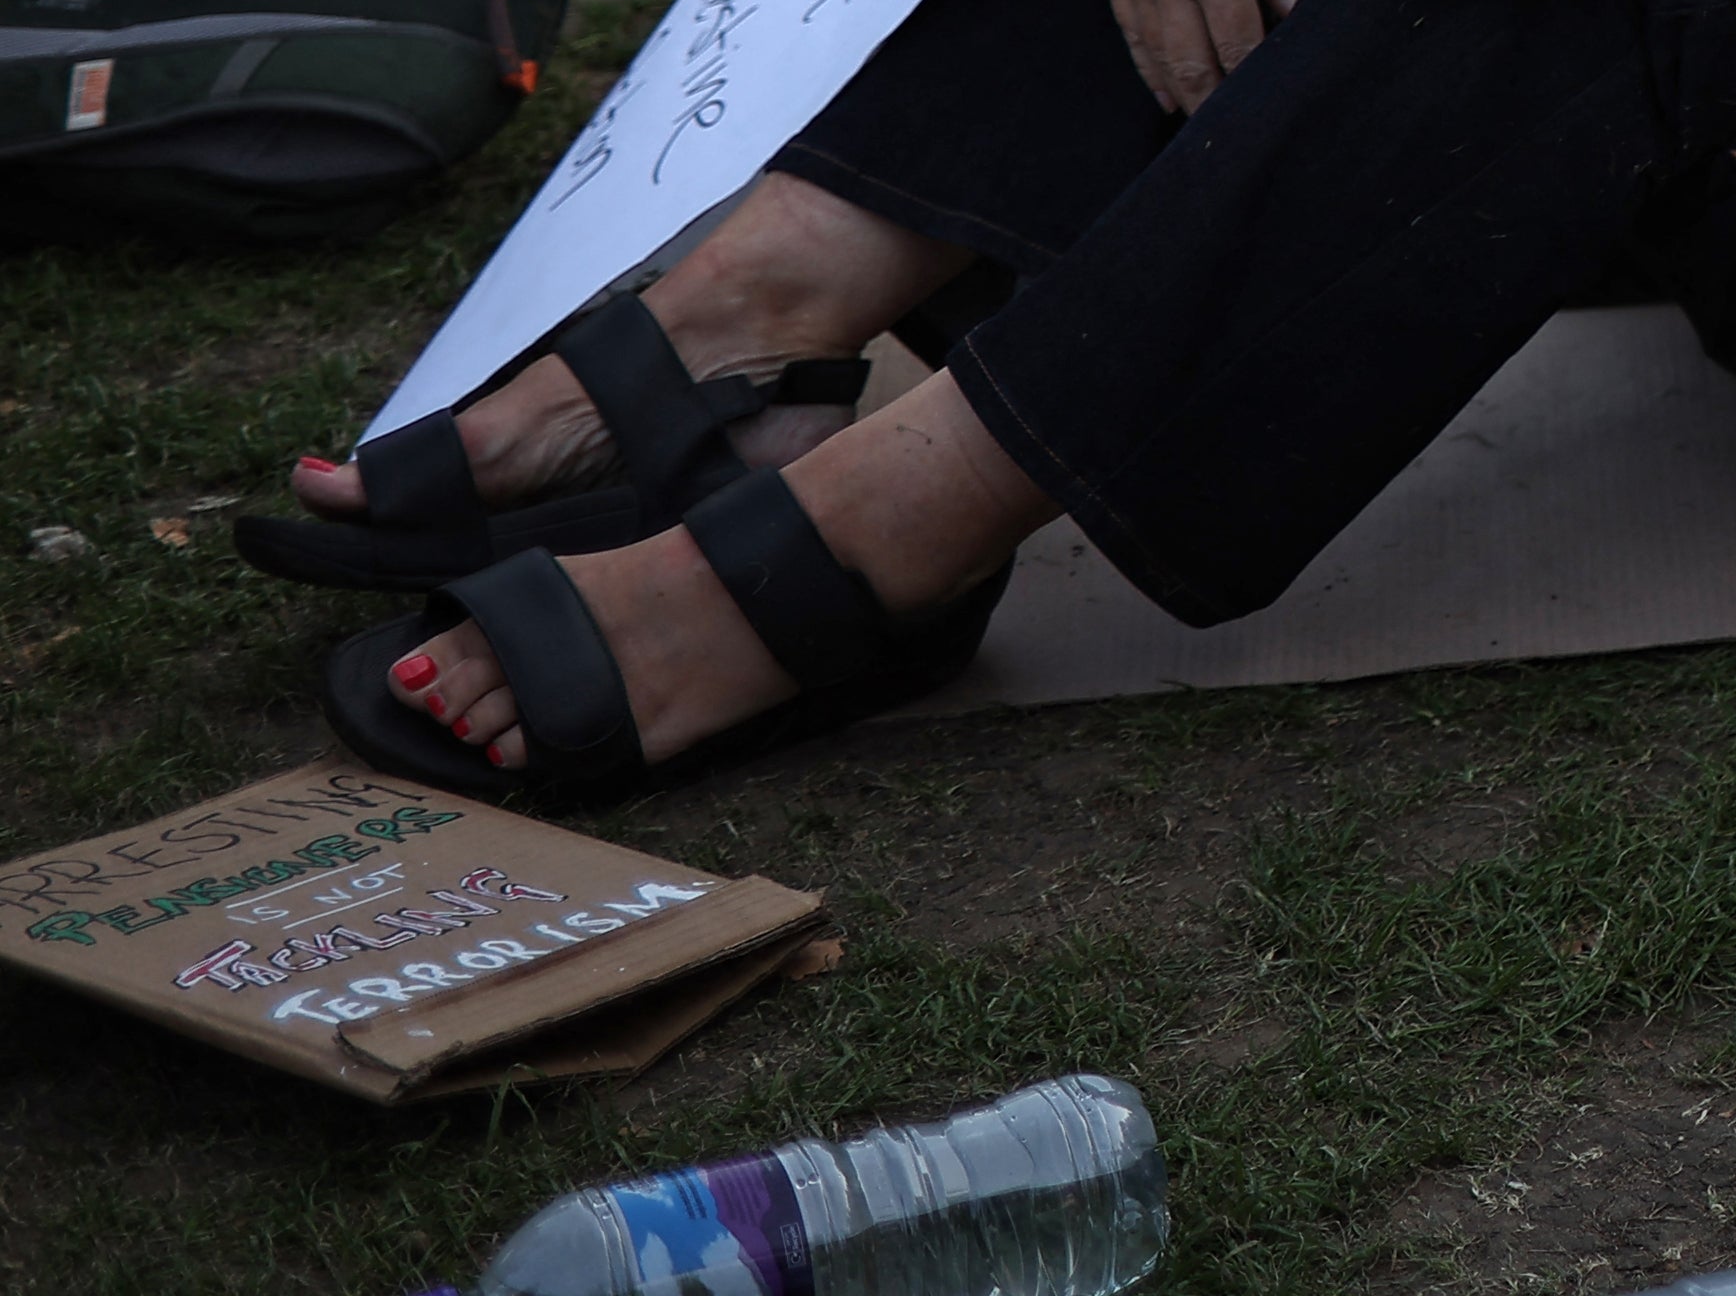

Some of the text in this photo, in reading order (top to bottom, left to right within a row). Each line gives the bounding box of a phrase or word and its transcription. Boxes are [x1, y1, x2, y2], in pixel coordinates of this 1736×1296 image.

[25, 806, 466, 945] PENSIONERS
[226, 863, 407, 925] IS NOT
